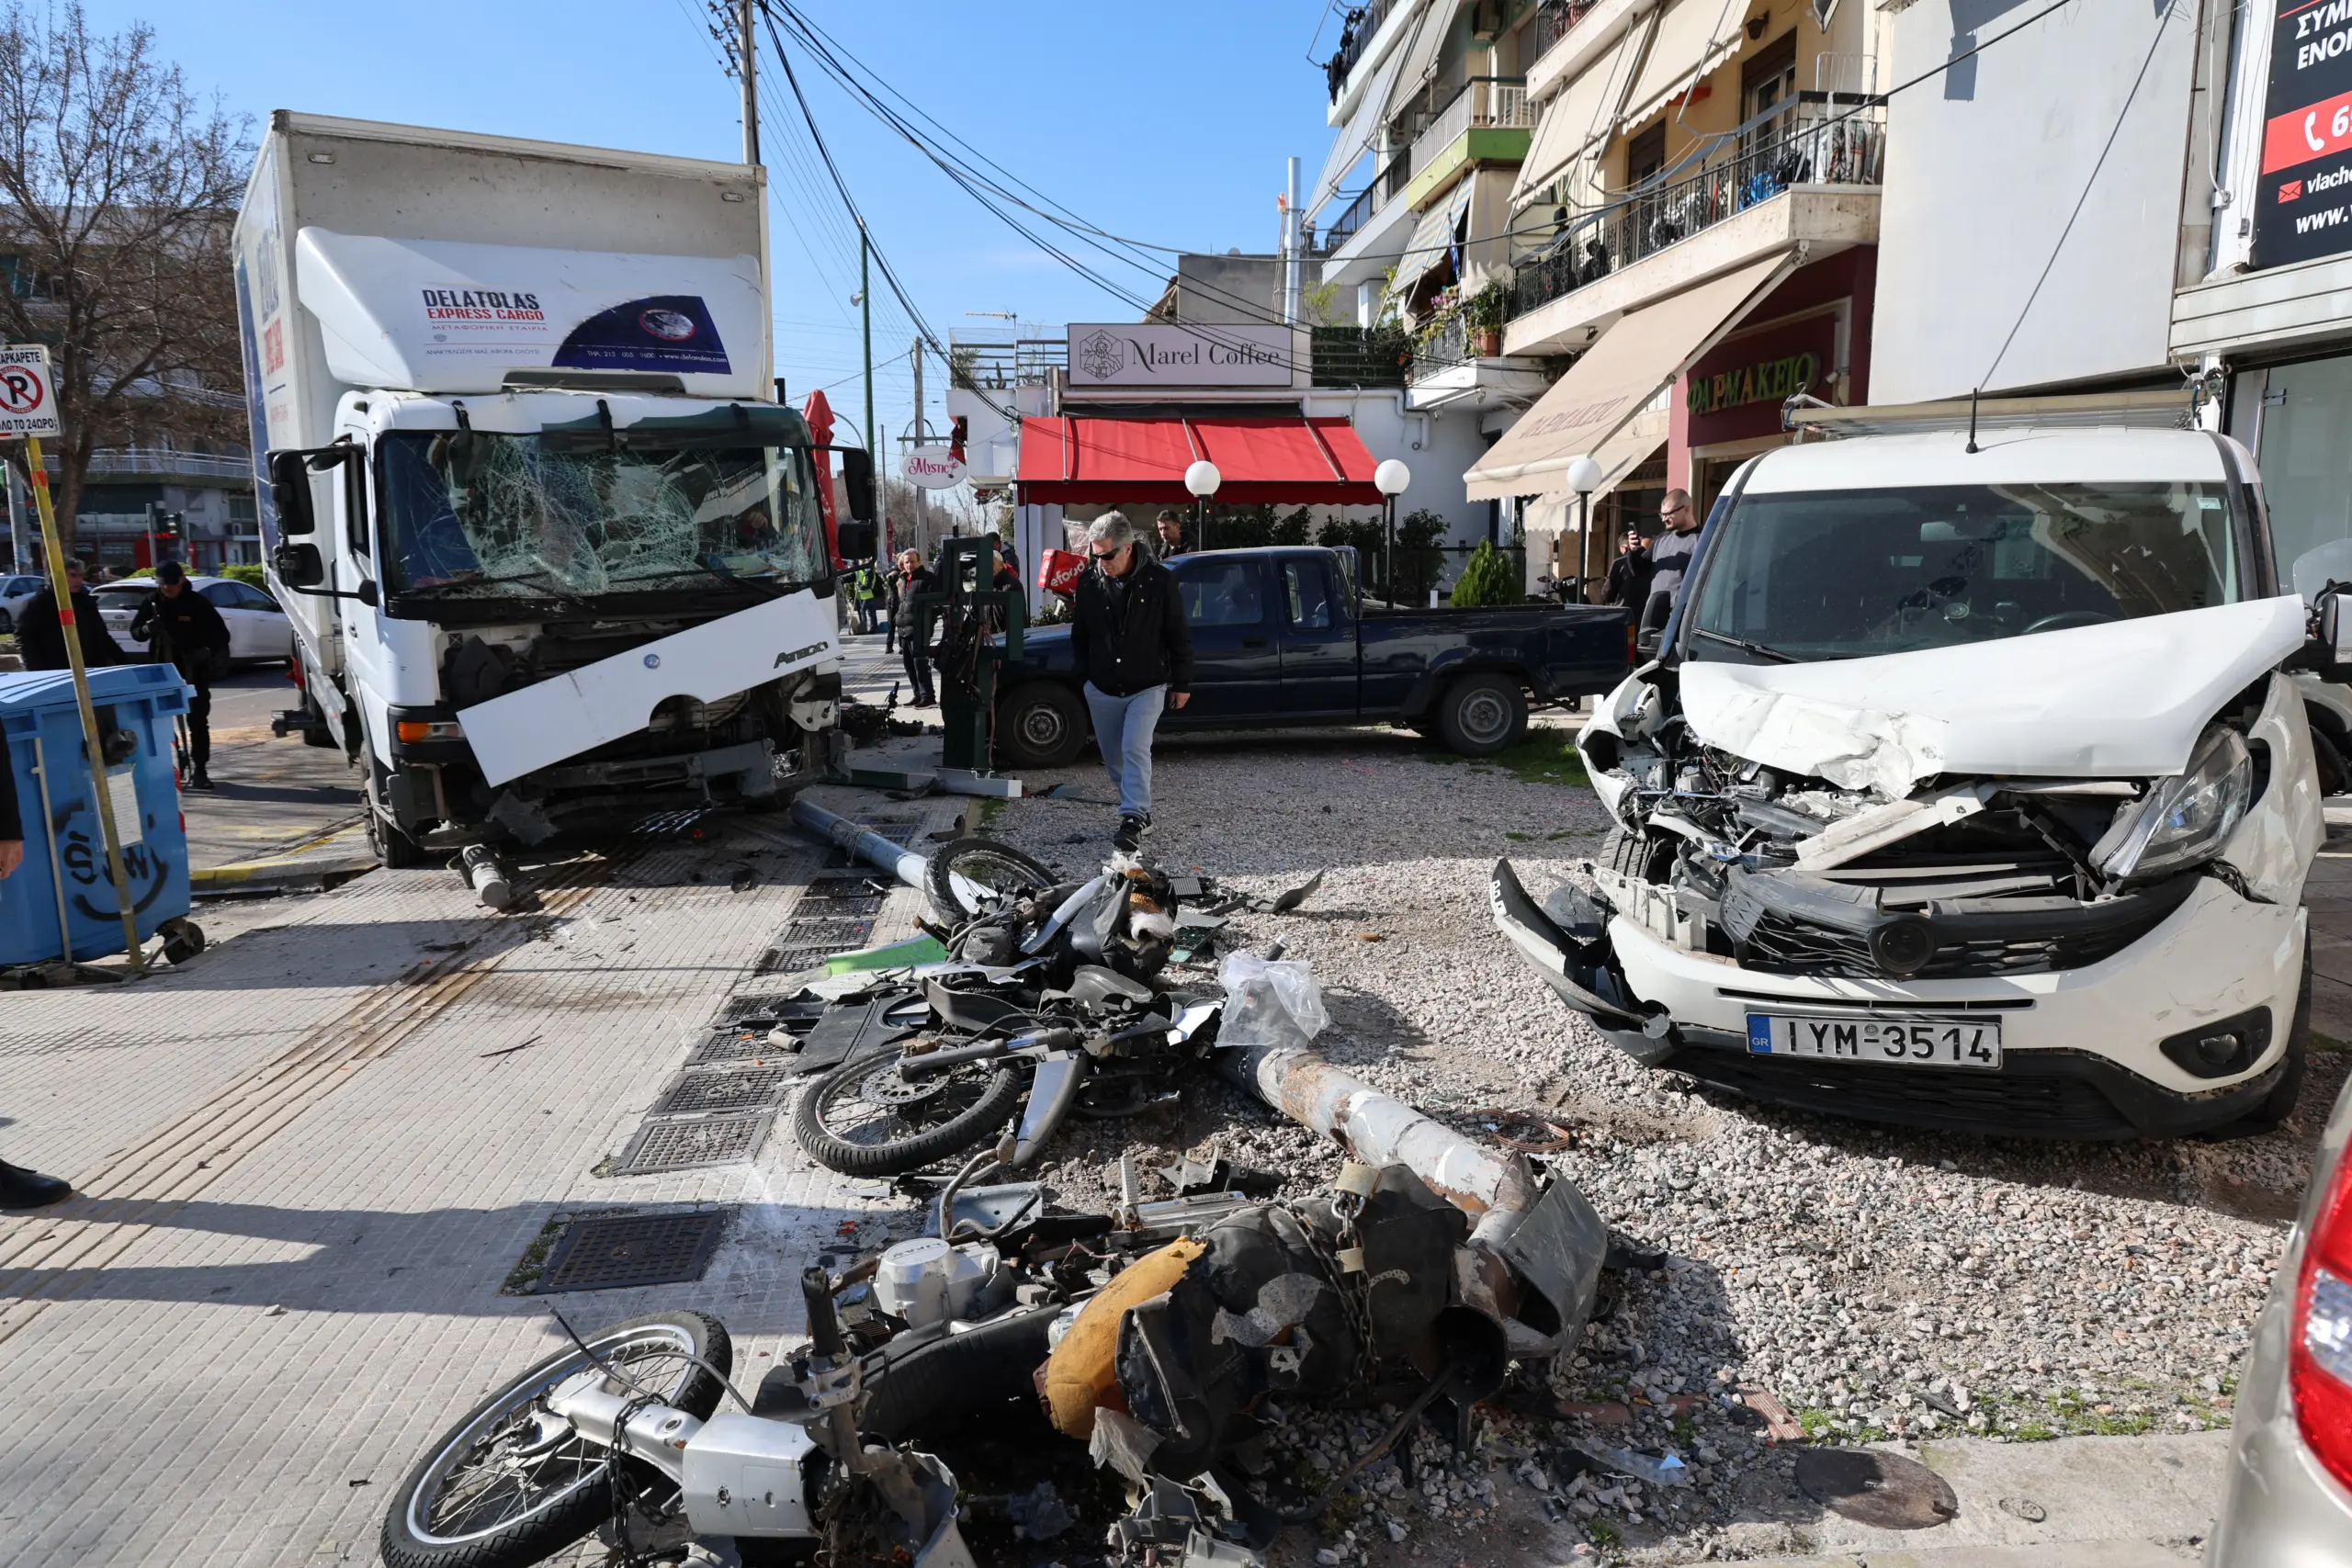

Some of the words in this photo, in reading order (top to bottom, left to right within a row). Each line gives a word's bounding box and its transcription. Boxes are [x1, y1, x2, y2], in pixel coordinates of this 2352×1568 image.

[2332, 105, 2352, 138] 6
[2296, 204, 2352, 234] www.
[422, 289, 539, 310] DELATOLAS
[427, 308, 492, 320] EXPRESS
[496, 310, 545, 321] CARGO
[0, 352, 41, 364] ΑΡΚΑΡΕΤΕ
[1123, 338, 1200, 374] Marel
[1208, 342, 1281, 366] Coffee
[1687, 352, 1817, 414] ΦΑΡΜΑΚΕΙΟ
[0, 420, 13, 431] ΛΟ
[14, 419, 25, 430] ΤΟ
[27, 418, 54, 430] 24ΩΡΟ
[1519, 395, 1629, 439] ΦΑΡΜΑΚΕΙΟ
[1050, 558, 1085, 586] efood
[1752, 1037, 1769, 1046] GR
